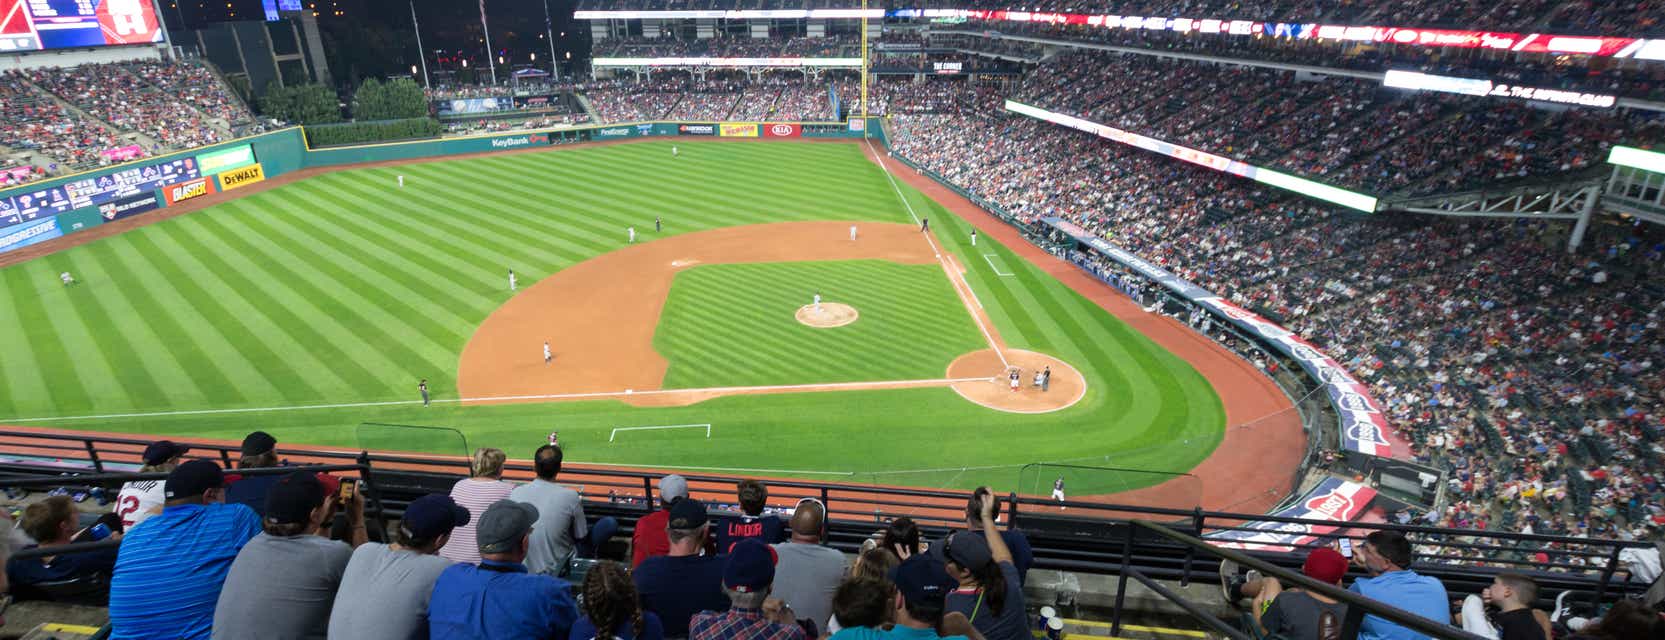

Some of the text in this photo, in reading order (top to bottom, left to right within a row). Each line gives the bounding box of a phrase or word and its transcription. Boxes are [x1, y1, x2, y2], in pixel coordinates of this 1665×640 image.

[492, 137, 529, 147] KeyBank
[116, 495, 139, 527] 12
[1315, 495, 1347, 516] 1997
[728, 522, 762, 537] LINDOR
